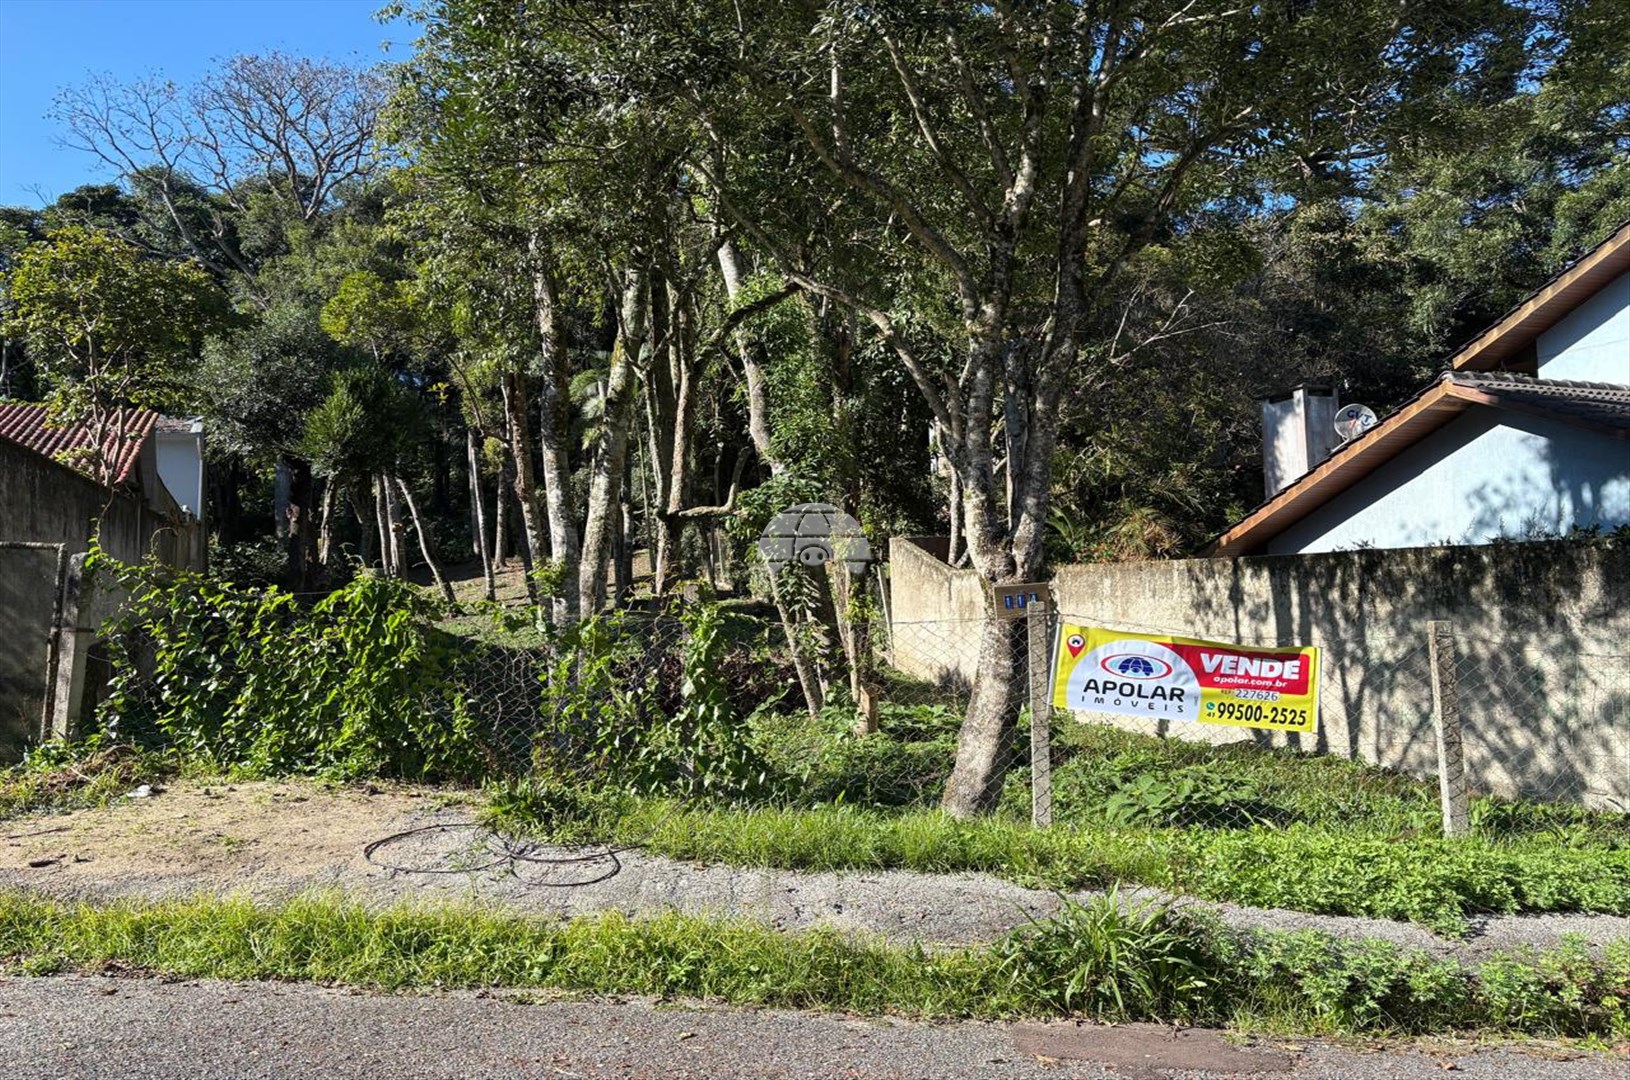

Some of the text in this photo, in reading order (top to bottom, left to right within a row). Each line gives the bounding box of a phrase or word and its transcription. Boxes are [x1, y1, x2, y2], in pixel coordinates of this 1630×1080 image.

[1200, 653, 1301, 680] VENDE
[1083, 678, 1185, 702] APOLAR
[1213, 676, 1288, 688] apolar.com.br
[1235, 689, 1279, 701] 227626
[1217, 702, 1307, 726] 99500-2525
